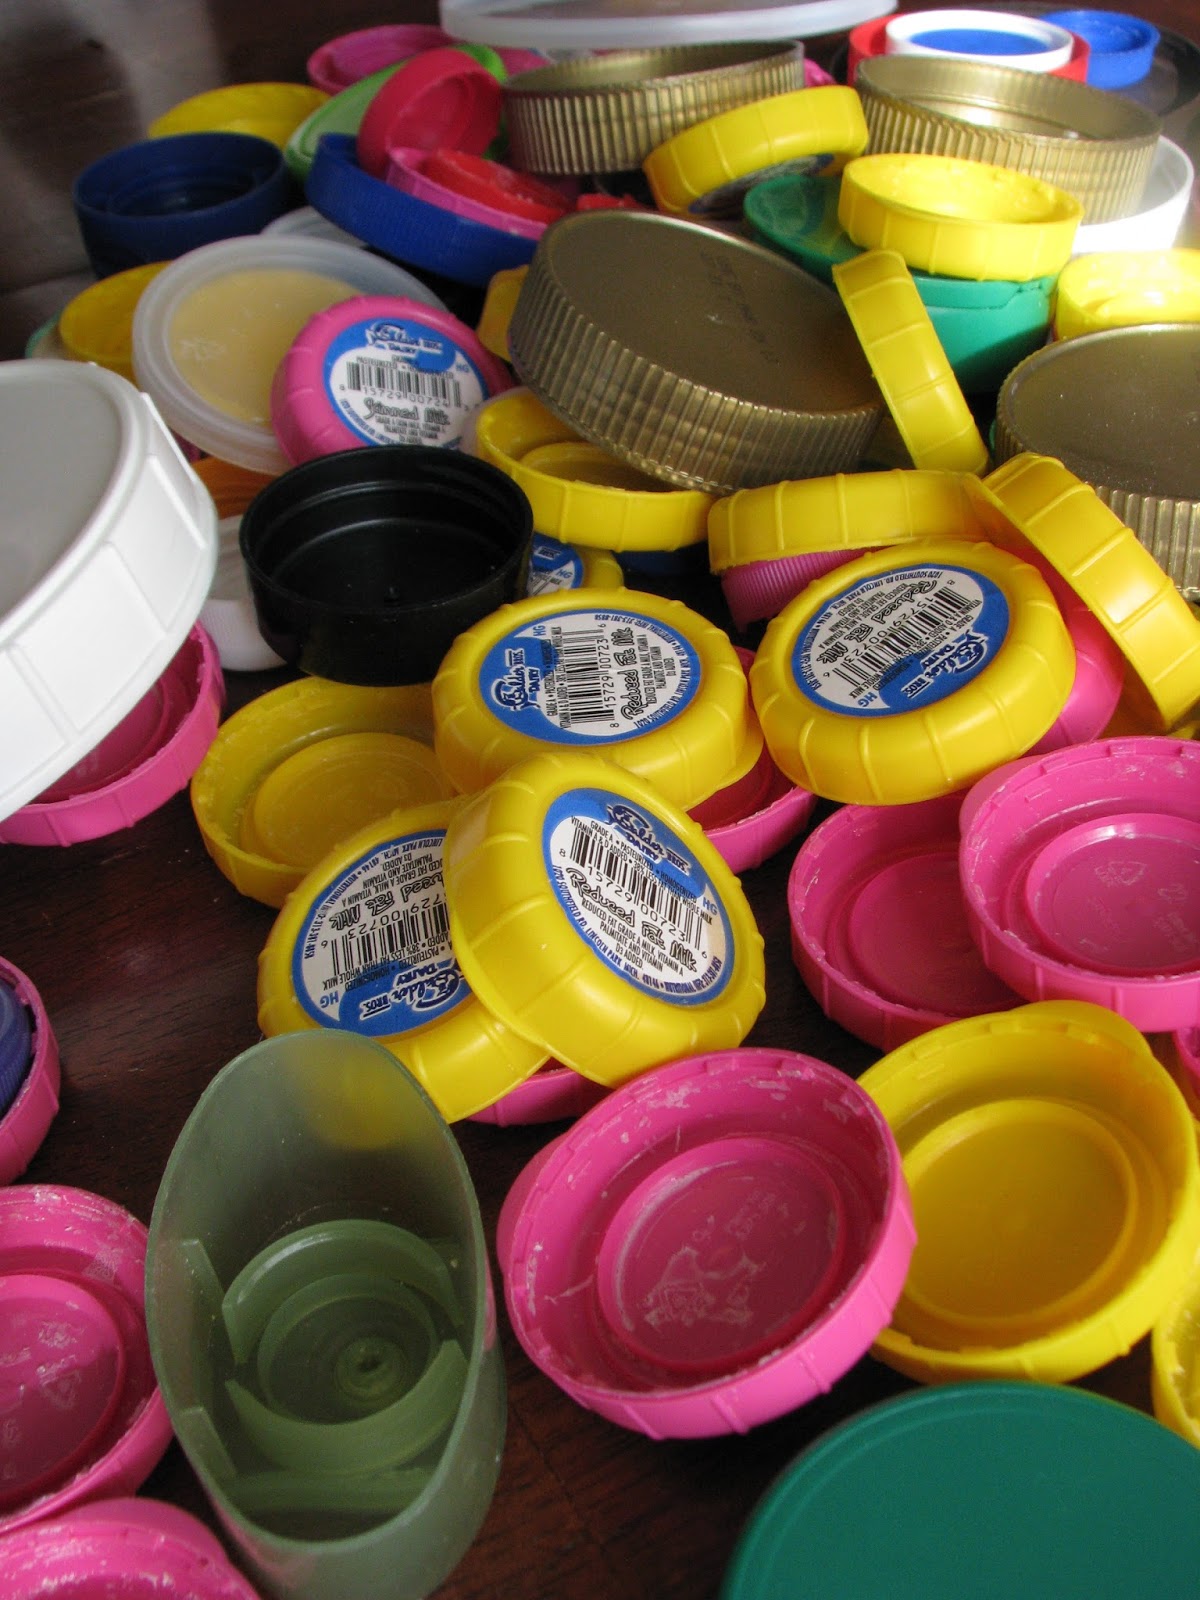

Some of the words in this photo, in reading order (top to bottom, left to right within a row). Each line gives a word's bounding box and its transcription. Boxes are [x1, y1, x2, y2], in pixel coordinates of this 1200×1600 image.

[455, 363, 469, 372] HG
[363, 386, 401, 400] 15729
[409, 393, 448, 407] 00724
[424, 407, 449, 425] Milk
[556, 569, 573, 578] HG
[894, 571, 926, 581] SOUTHFIELD
[945, 578, 955, 586] 8
[858, 579, 882, 593] LINCOLN
[883, 582, 909, 601] REDUCED
[845, 590, 860, 601] PARK
[857, 590, 885, 610] PALMITATE
[871, 580, 935, 626] Reduced
[875, 597, 888, 606] FAT
[846, 607, 861, 618] AND
[859, 603, 879, 618] GRADE
[889, 595, 934, 628] 15729
[958, 597, 982, 615] VITAMIN
[532, 624, 546, 636] HG
[827, 615, 851, 633] VITAMIN
[953, 613, 974, 629] GRADE
[611, 627, 634, 646] Milk
[821, 628, 846, 646] VITAMIN
[844, 623, 873, 642] Fat
[927, 623, 947, 638] ADDED
[596, 638, 611, 669] 00723
[815, 641, 848, 664] Milk
[841, 629, 888, 663] 00723
[899, 646, 916, 659] LESS
[912, 633, 947, 659] PASTEURIZED
[613, 648, 637, 665] Fat
[918, 642, 955, 670] DAIRY
[924, 642, 983, 676] Calder
[526, 667, 540, 692] DAIRY
[821, 670, 831, 678] 6
[860, 672, 883, 689] WHOLE
[494, 666, 527, 706] Calder
[600, 674, 616, 708] 15729
[620, 669, 648, 719] Reduced
[848, 685, 866, 698] MILK
[901, 676, 927, 696] BROS.
[545, 701, 558, 716] GRADE
[855, 691, 878, 708] HG
[402, 841, 416, 853] PARK
[416, 838, 442, 848] LINCOLN
[613, 804, 664, 855] Calder
[665, 850, 687, 873] BROS.
[625, 831, 659, 863] DAIRY
[401, 852, 432, 872] PALMITATE
[417, 864, 427, 876] FAT
[570, 815, 593, 837] VITAMIN
[593, 831, 597, 841] A
[598, 835, 603, 844] &
[604, 839, 608, 848] D
[609, 843, 627, 862] ADDED
[633, 860, 645, 875] 38%
[645, 869, 657, 884] LESS
[657, 878, 667, 891] FAT
[667, 885, 682, 902] THAN
[681, 895, 700, 916] WHOLE
[700, 909, 713, 925] MILK
[590, 819, 608, 839] GRADE
[609, 833, 613, 842] A
[620, 841, 653, 871] PASTEURIZED
[660, 871, 697, 903] HOMOGENIZED
[362, 872, 386, 888] VITAMIN
[386, 865, 401, 878] AND
[395, 869, 415, 884] GRADE
[324, 873, 358, 904] NUTRITIONAL
[389, 877, 395, 887] A
[341, 897, 346, 907] A
[346, 887, 371, 904] VITAMIN
[365, 891, 394, 915] Fat
[559, 847, 566, 858] 8
[587, 863, 632, 905] 15729
[640, 902, 685, 943] 00723
[701, 949, 707, 959] 6
[702, 896, 718, 916] HG
[328, 903, 360, 929] Milk
[347, 909, 400, 939] 00723
[557, 882, 581, 918] SOUTHFIELD
[576, 917, 588, 929] RD.
[585, 927, 608, 954] LINCOLN
[606, 949, 622, 966] PARK
[566, 869, 635, 928] Reduced
[641, 921, 665, 950] Fat
[669, 940, 696, 972] Milk
[320, 938, 328, 949] 6
[426, 930, 449, 947] ADDED
[581, 895, 607, 922] REDUCED
[607, 914, 617, 929] FAT
[617, 921, 635, 942] GRADE
[636, 935, 641, 946] A
[656, 950, 679, 973] VITAMIN
[679, 966, 684, 977] A
[391, 948, 405, 962] LESS
[406, 942, 420, 955] 38%
[599, 920, 628, 948] PALMITATE
[628, 940, 640, 956] AND
[641, 949, 663, 973] VITAMIN
[361, 959, 378, 974] THAN
[379, 954, 390, 966] FAT
[398, 945, 439, 970] PASTEURIZED
[322, 976, 338, 990] MILK
[338, 966, 360, 984] WHOLE
[395, 961, 437, 987] DAIRY
[391, 971, 458, 1008] Calder
[318, 990, 339, 1009] HG
[363, 994, 388, 1012] BROS.
